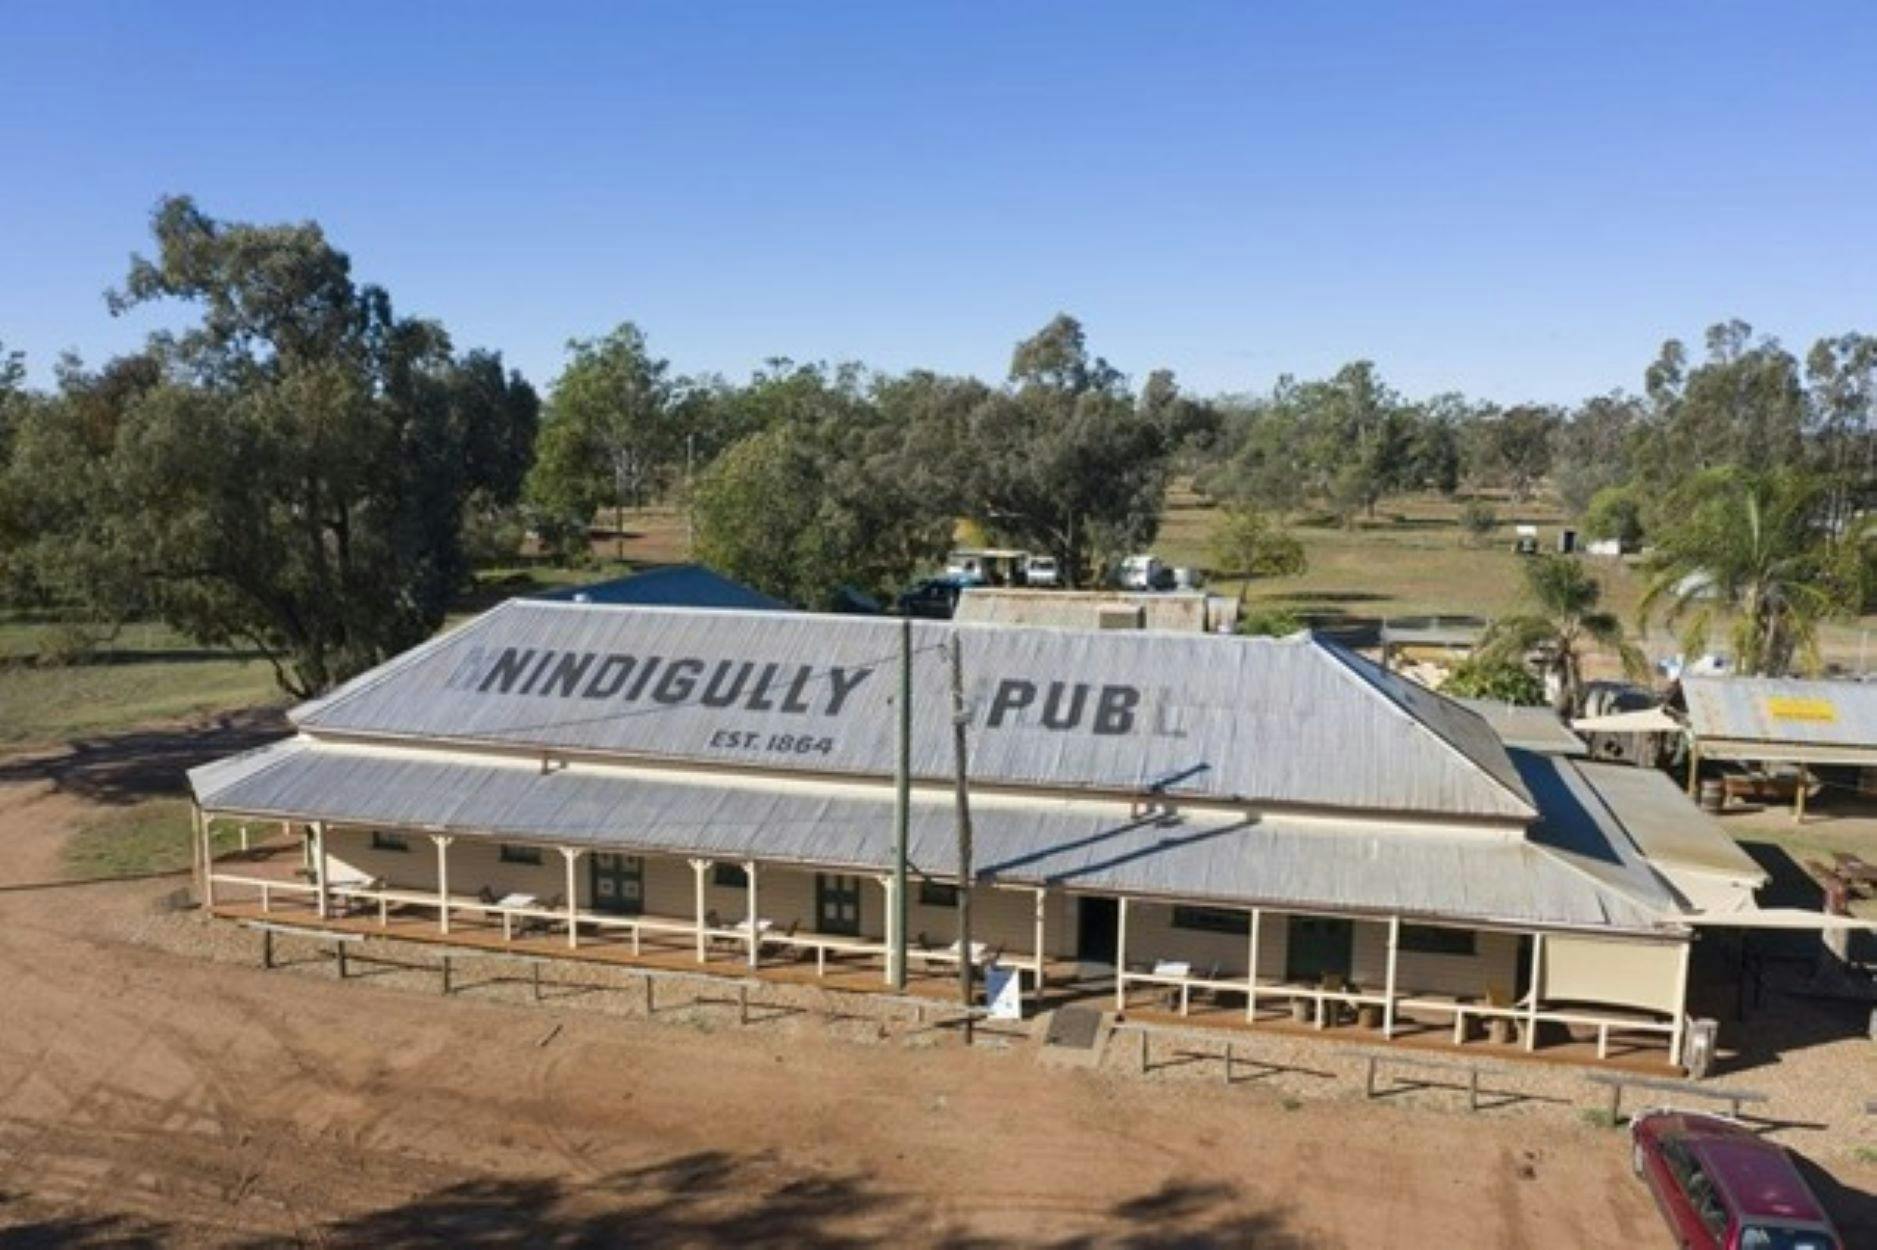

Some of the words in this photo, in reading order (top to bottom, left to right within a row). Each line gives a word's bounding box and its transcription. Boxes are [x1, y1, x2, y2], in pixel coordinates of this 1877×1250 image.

[477, 647, 875, 717] NINDIGULLY
[986, 678, 1141, 736] PUB
[710, 730, 761, 750] EST.
[766, 734, 833, 755] 1864
